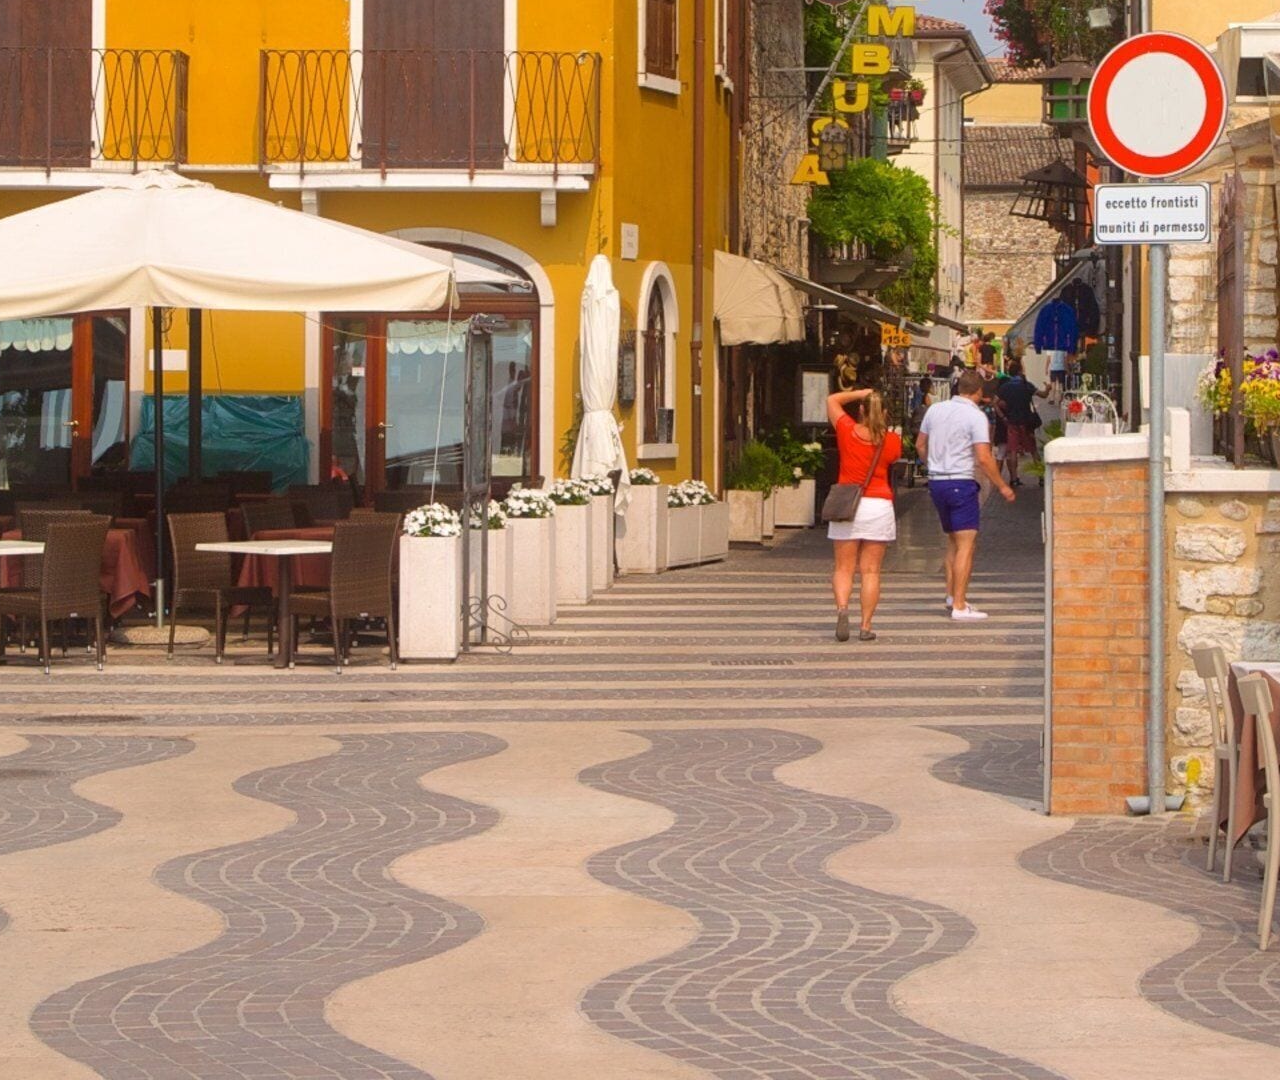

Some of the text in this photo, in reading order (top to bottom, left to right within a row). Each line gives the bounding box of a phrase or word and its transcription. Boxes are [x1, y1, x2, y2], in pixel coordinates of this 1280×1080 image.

[1105, 195, 1199, 209] eccetto frontisti
[1099, 221, 1205, 236] muniti di permesso
